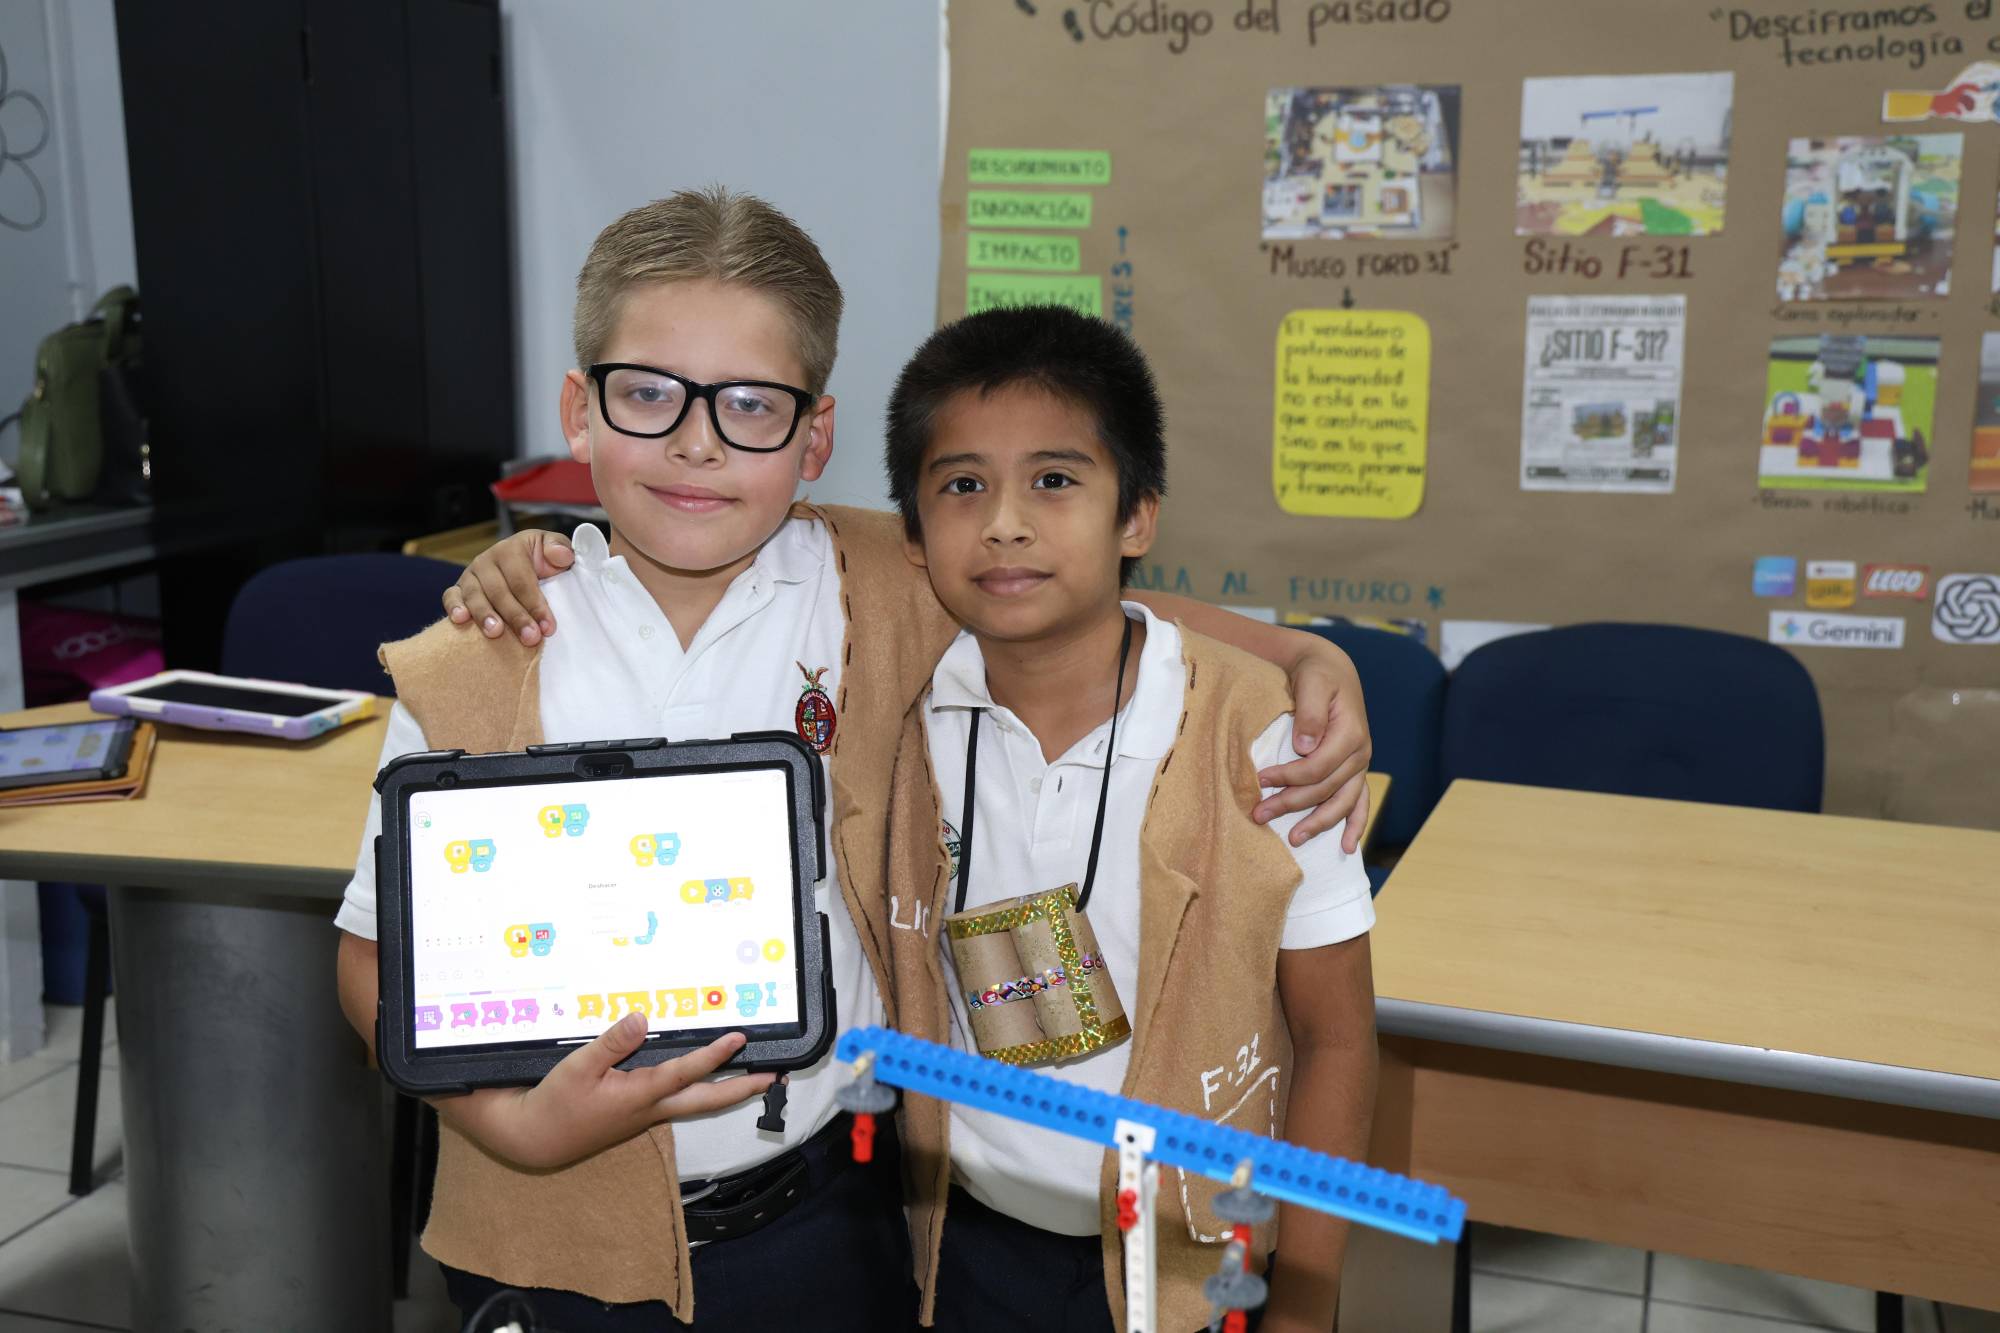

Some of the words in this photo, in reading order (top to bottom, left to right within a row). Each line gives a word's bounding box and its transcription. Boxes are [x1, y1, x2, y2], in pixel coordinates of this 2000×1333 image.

[1232, 0, 1280, 33] del
[1308, 0, 1452, 47] pasado
[1781, 32, 1963, 70] tecnología
[971, 198, 1087, 222] INNOVACIÓN
[978, 241, 1075, 264] IMPACTO
[1356, 253, 1420, 277] FORD
[1524, 240, 1602, 279] Sitio
[1617, 244, 1694, 279] F-31
[1540, 329, 1605, 367] ¿SITIO
[1609, 329, 1669, 361] F-31?
[1221, 570, 1257, 595] AL
[1289, 575, 1410, 603] FUTURO
[1866, 569, 1925, 593] LEGO
[1808, 619, 1898, 643] Gemini
